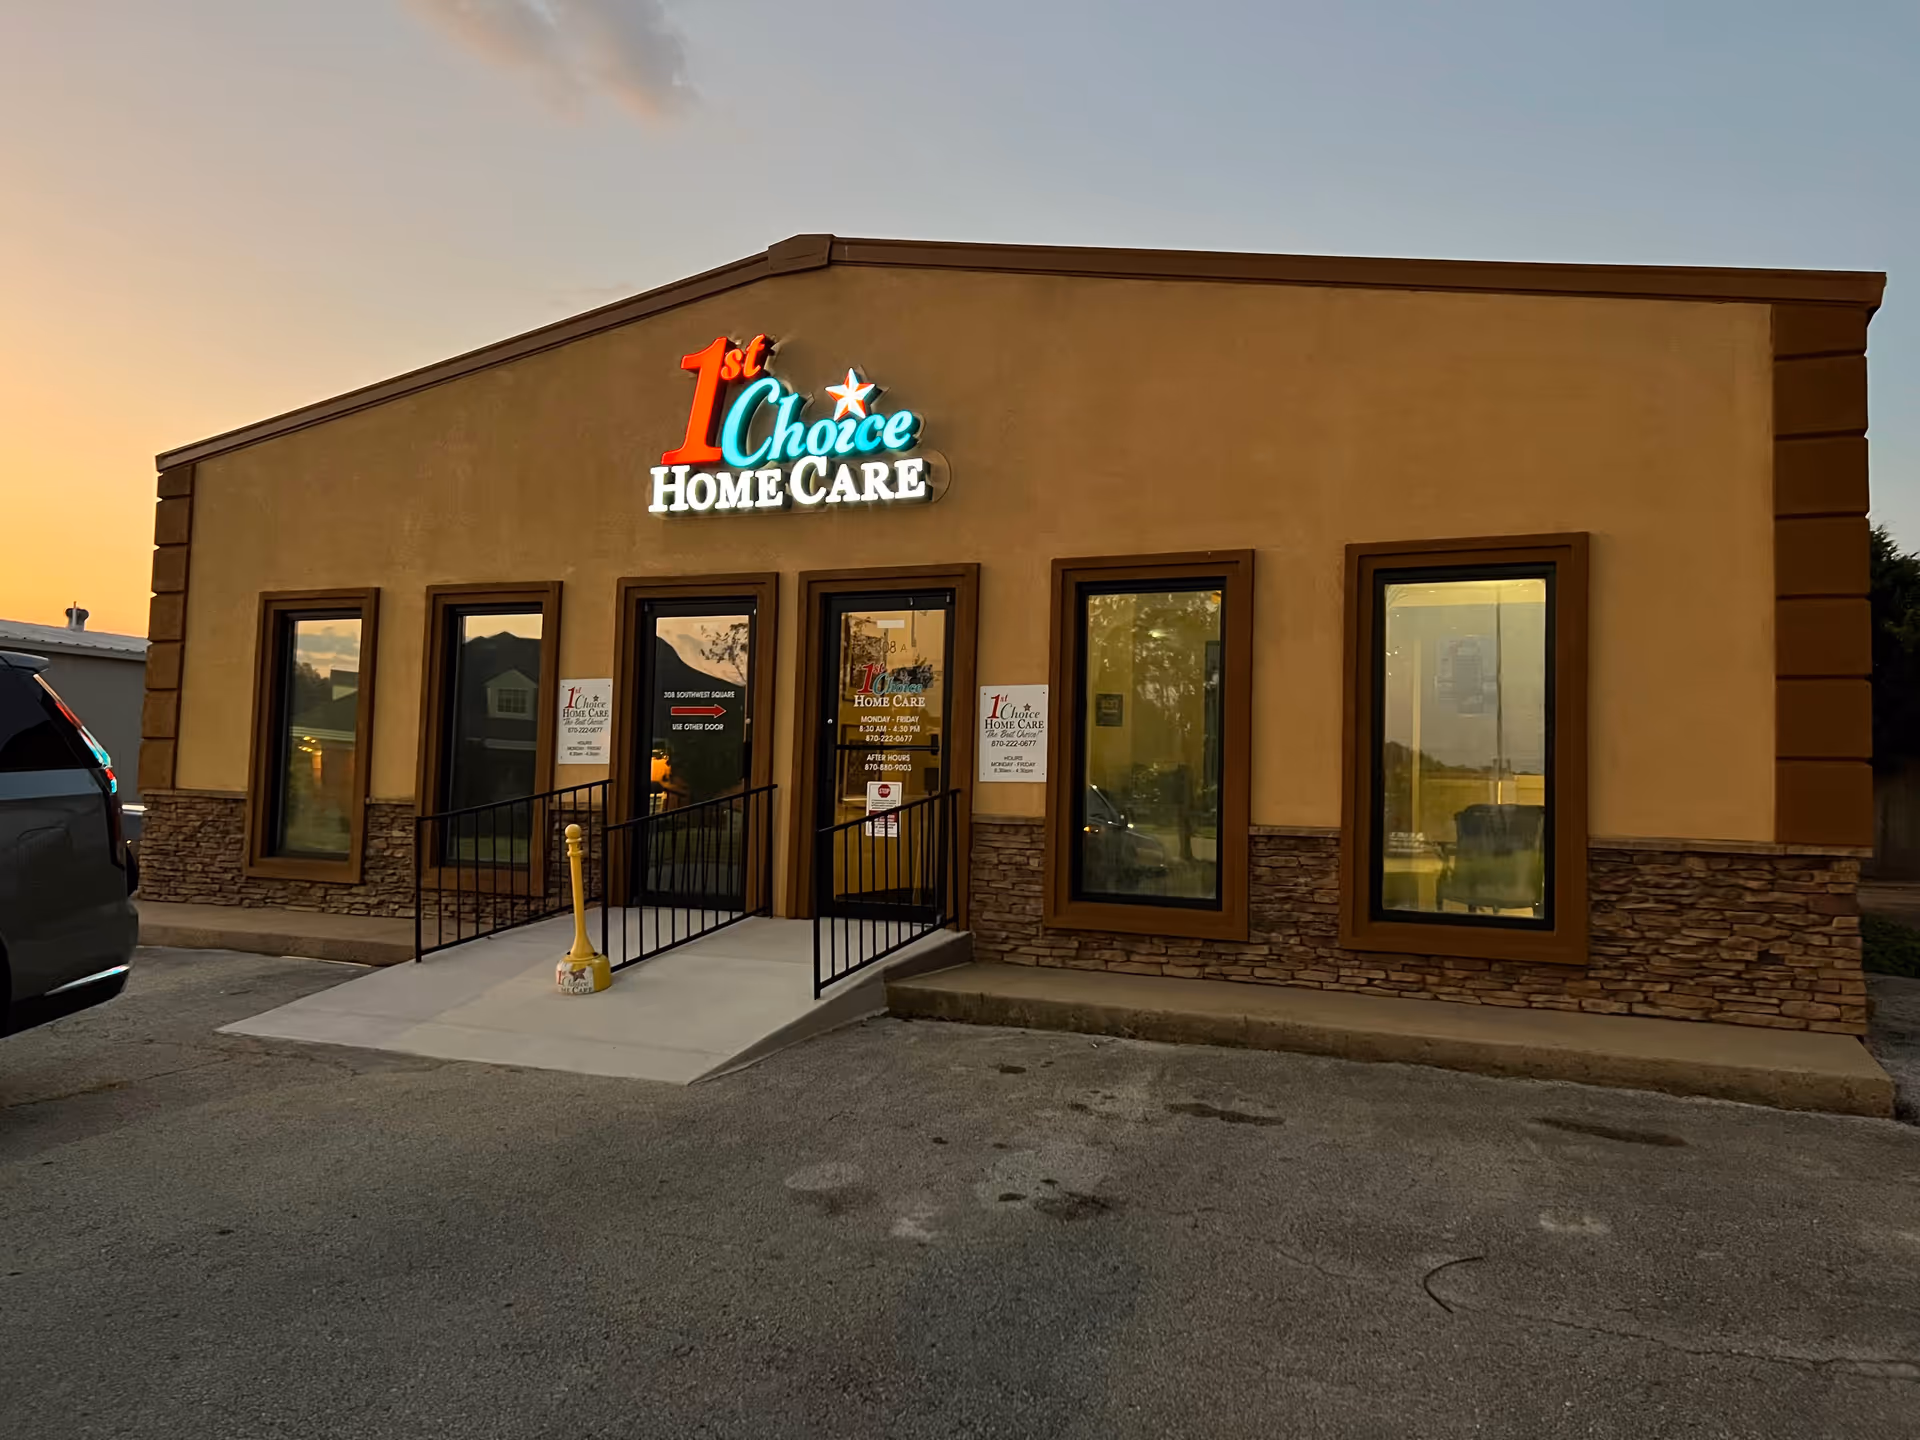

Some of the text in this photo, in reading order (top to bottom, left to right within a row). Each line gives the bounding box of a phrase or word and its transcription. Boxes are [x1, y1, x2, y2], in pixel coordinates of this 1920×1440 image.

[661, 333, 766, 466] 1st
[721, 376, 914, 468] Choice
[648, 455, 926, 514] HOME CARE
[858, 662, 885, 695] 1st
[872, 672, 924, 696] Choice
[574, 694, 607, 710] Choice
[663, 691, 676, 699] 308
[711, 690, 735, 698] SQUARE
[853, 694, 926, 708] HOME CARE
[562, 708, 587, 718] HOME
[987, 693, 1009, 720] 1st
[1000, 702, 1041, 720] Choice
[861, 715, 891, 723] MONDAY
[896, 715, 919, 723] FRIDAY
[984, 718, 1045, 730] HOME CARE
[859, 725, 874, 733] 8:30
[875, 725, 887, 733] AM
[893, 725, 908, 733] 4:30
[910, 725, 920, 733] PM
[1000, 729, 1015, 738] Best
